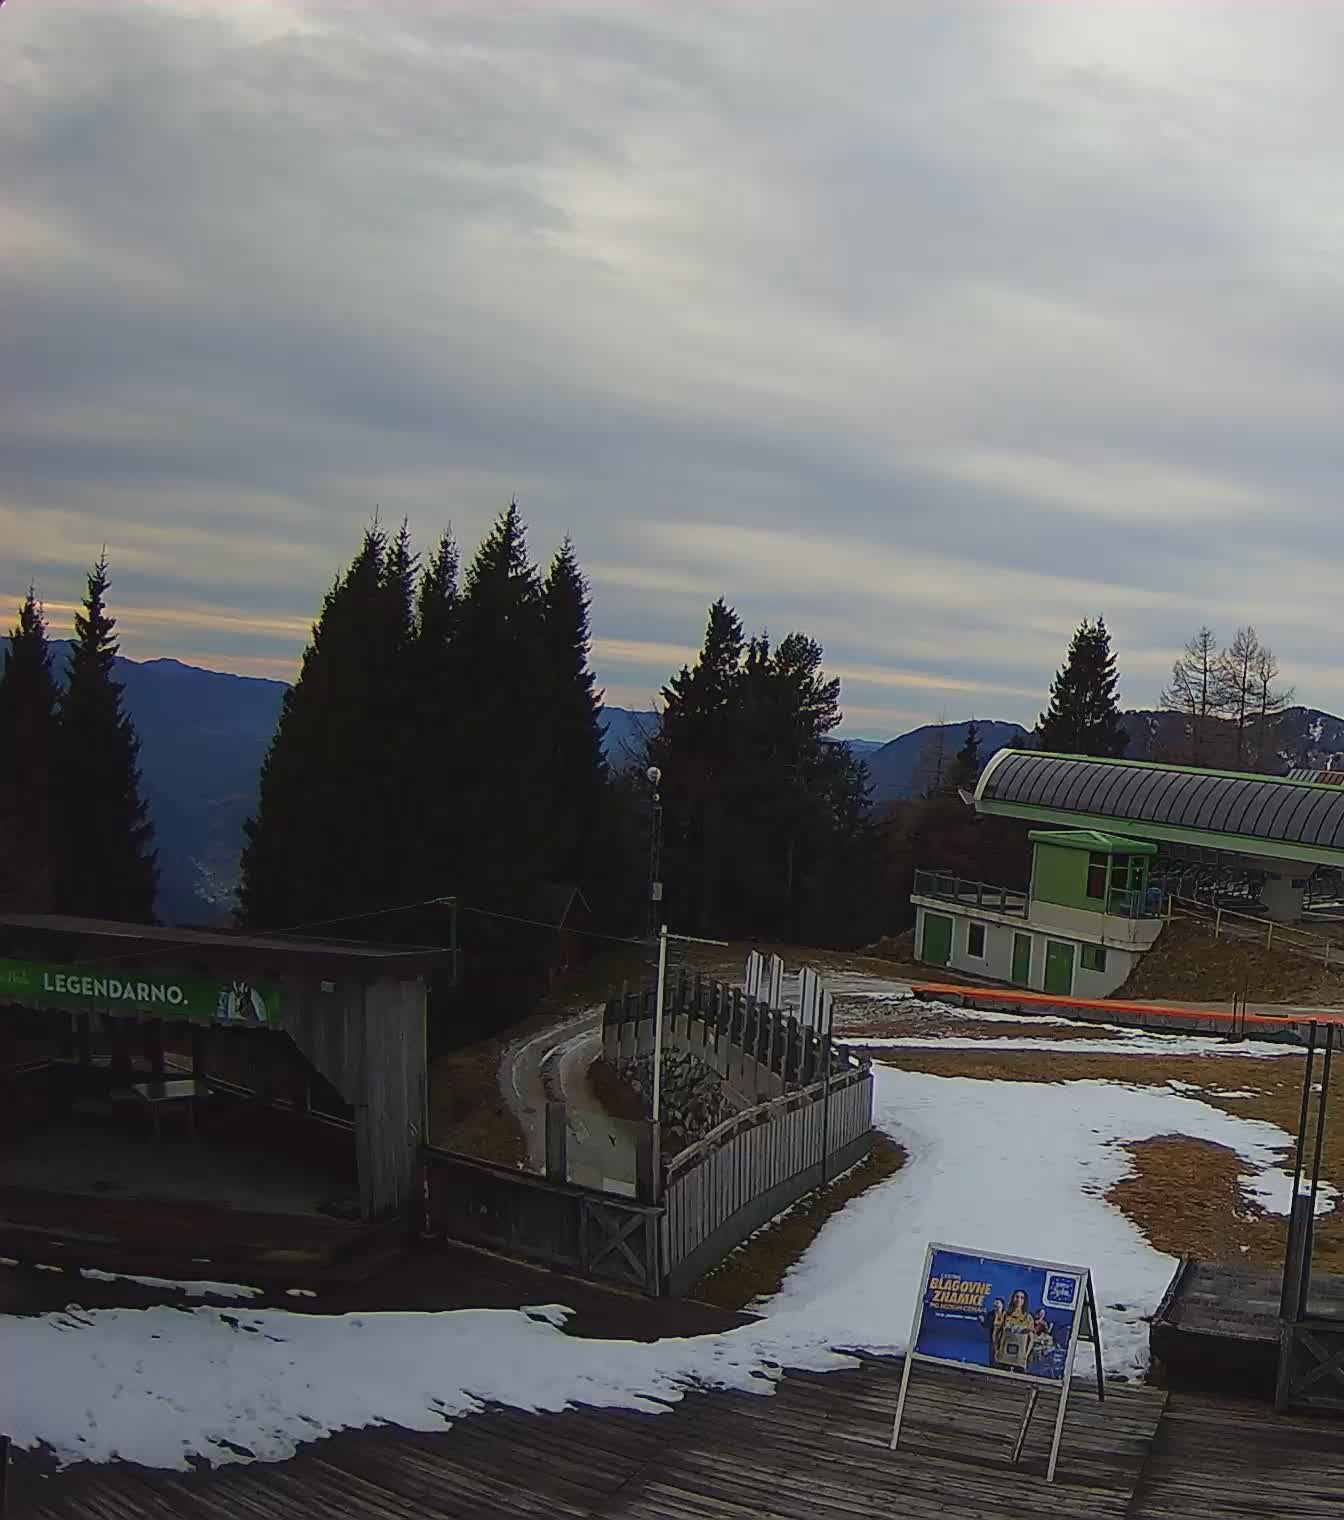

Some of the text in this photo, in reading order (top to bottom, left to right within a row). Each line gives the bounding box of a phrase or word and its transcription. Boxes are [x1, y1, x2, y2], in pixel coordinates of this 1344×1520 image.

[43, 972, 189, 1005] LEGENDARNO.
[930, 1278, 993, 1295] BLAGOVNE
[932, 1290, 985, 1306] ZNAMKE
